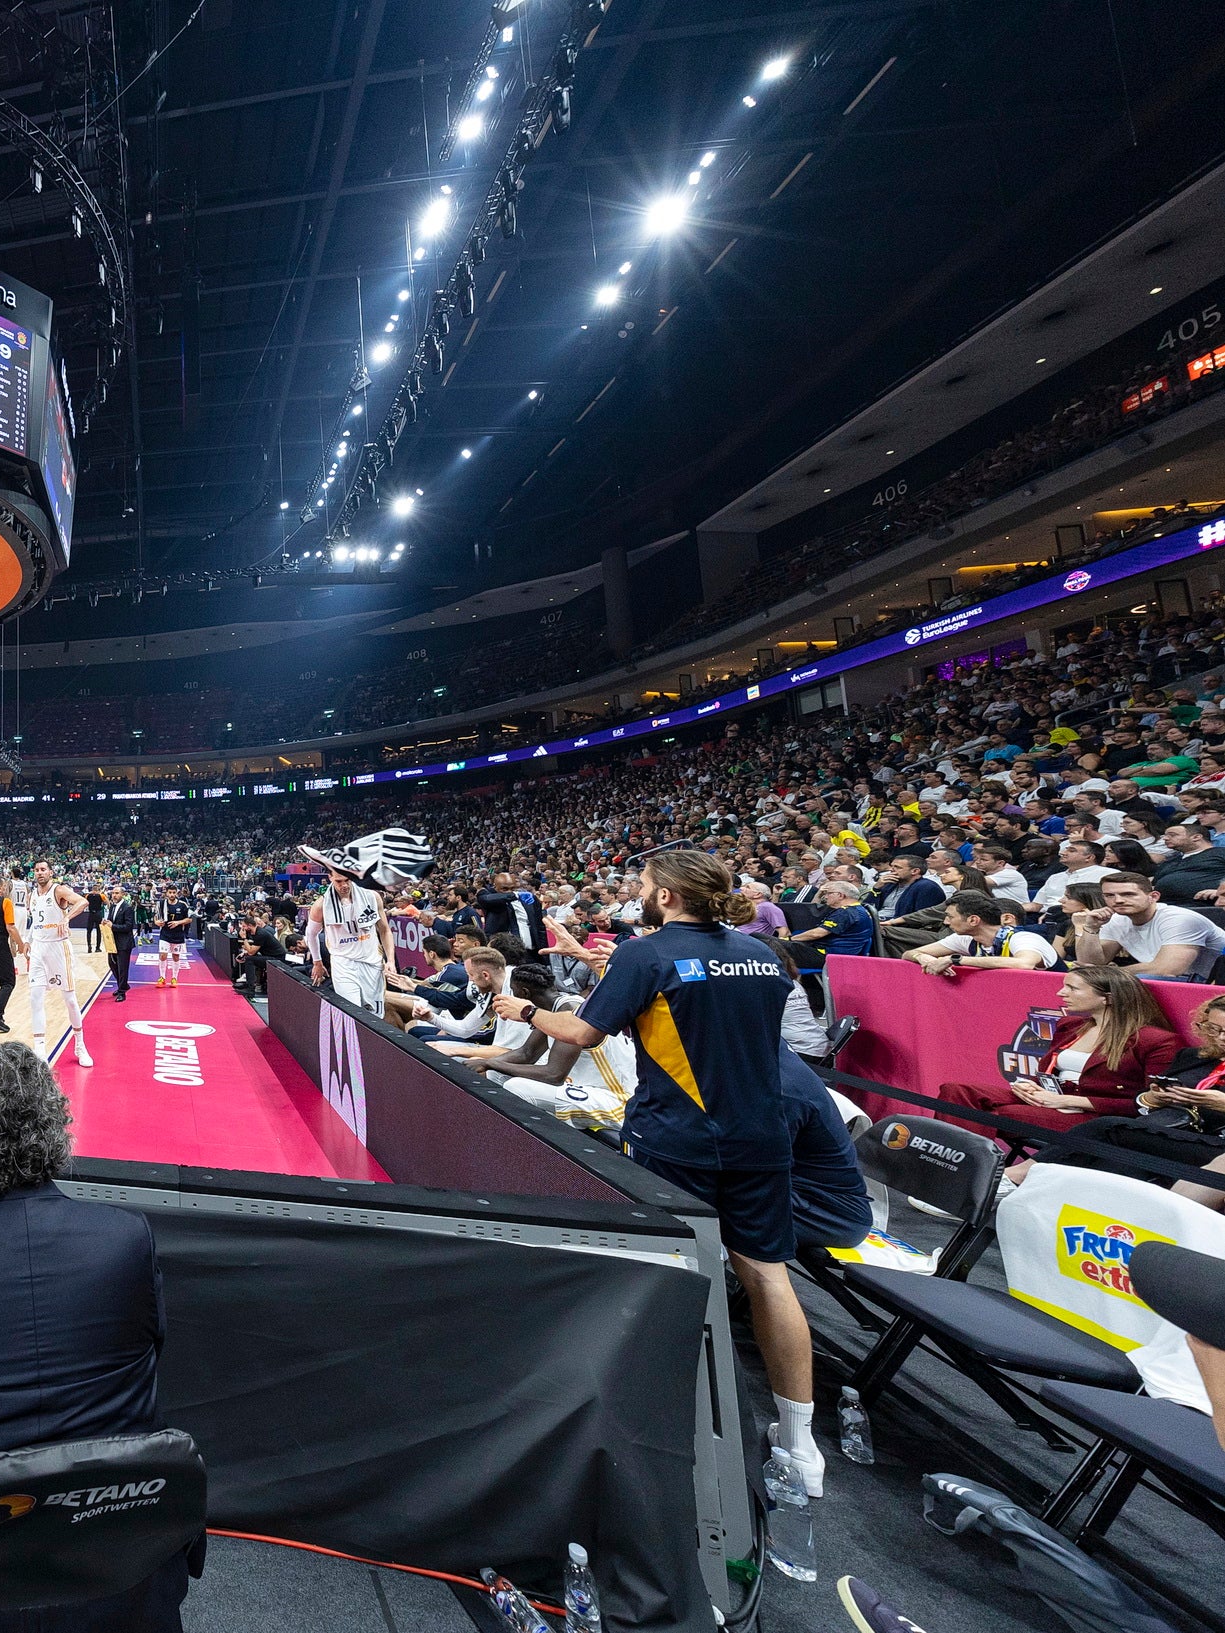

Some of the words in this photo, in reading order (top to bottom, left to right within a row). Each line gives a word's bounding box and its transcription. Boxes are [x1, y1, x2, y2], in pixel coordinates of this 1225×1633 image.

[1157, 304, 1221, 351] 405
[872, 480, 908, 506] 406
[540, 610, 563, 626] 407
[922, 618, 950, 632] TURKISH
[951, 607, 982, 623] AIRLINES
[922, 620, 968, 640] EuroLeague
[406, 648, 427, 661] 408
[300, 671, 317, 681] 409
[16, 891, 25, 902] 17
[38, 910, 44, 922] 5
[346, 921, 358, 934] 11
[340, 934, 371, 944] AUTOHERO
[708, 959, 780, 976] Sanitas
[56, 974, 62, 986] 5
[153, 1036, 205, 1086] BETANO
[910, 1136, 966, 1164] BETANO
[919, 1154, 958, 1172] SPORTWETTEN
[43, 1478, 166, 1507] BETANO
[70, 1497, 160, 1524] SPORTWETTEN
